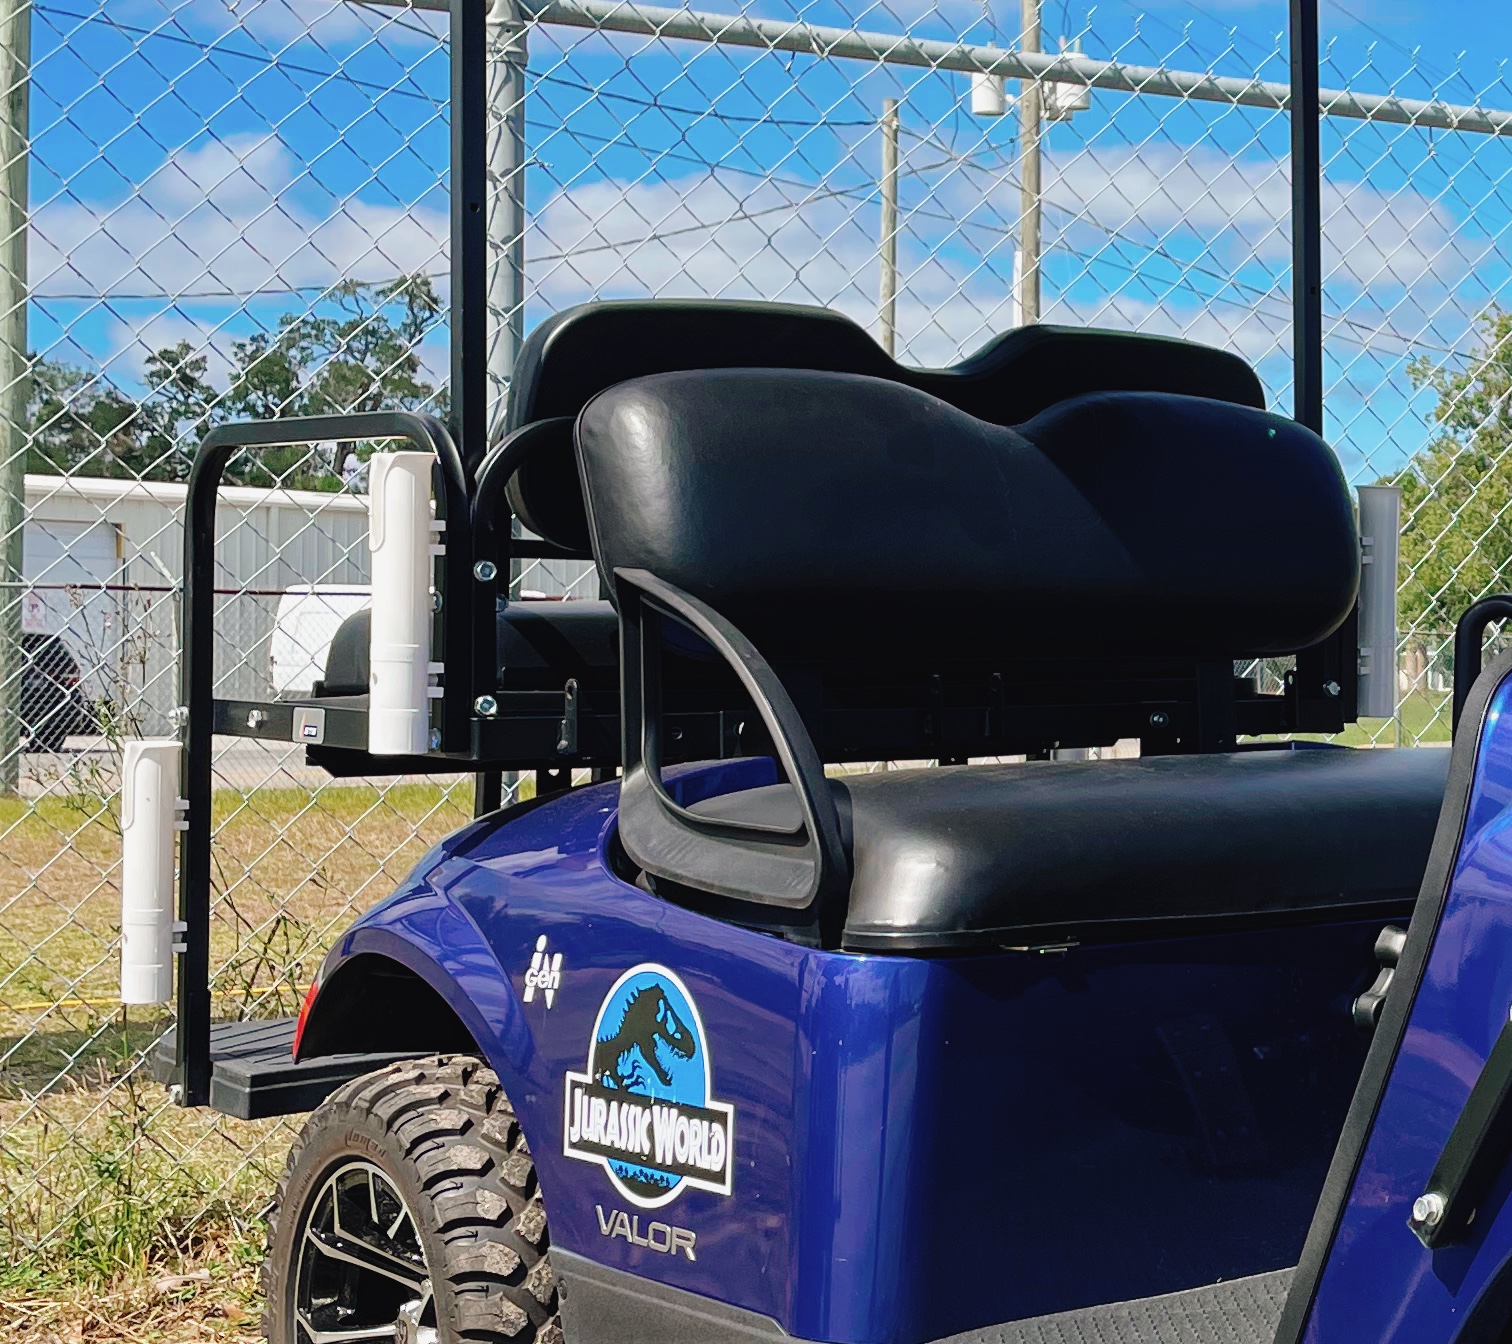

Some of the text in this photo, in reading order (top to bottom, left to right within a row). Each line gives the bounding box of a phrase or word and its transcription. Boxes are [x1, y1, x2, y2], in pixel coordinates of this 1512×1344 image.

[569, 1087, 726, 1173] JURASSIC WORLD
[595, 1204, 697, 1262] VALOR
